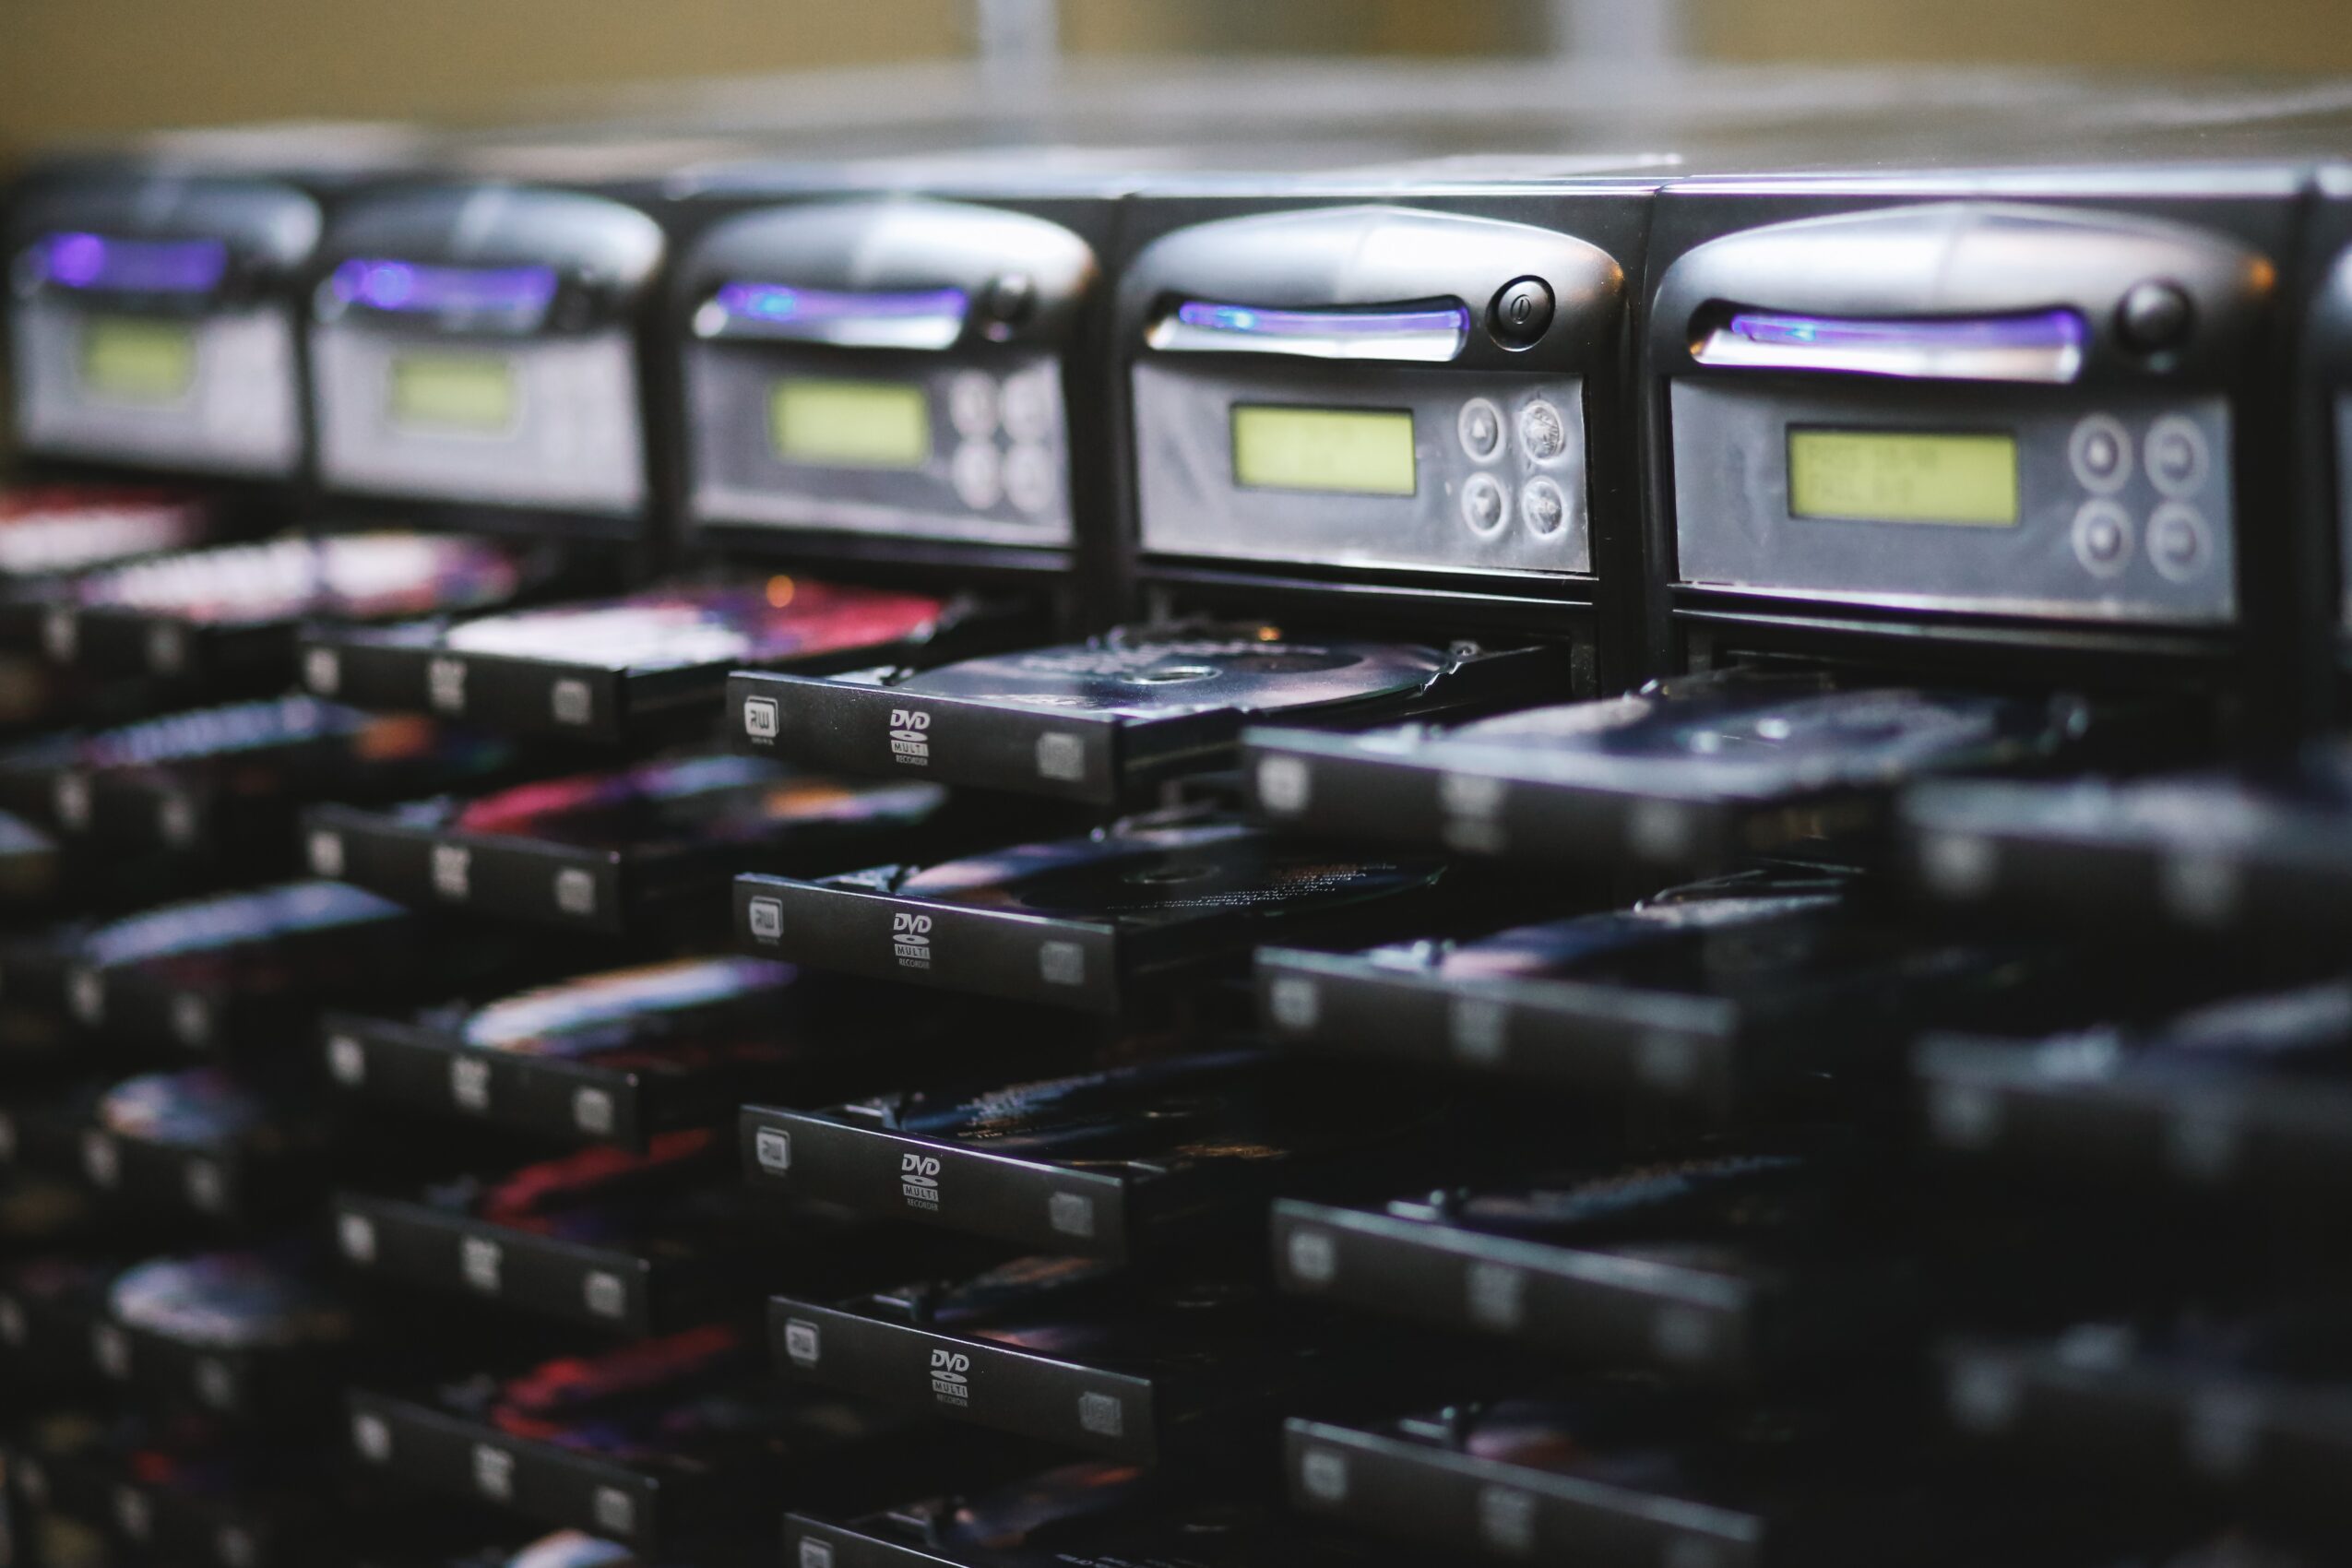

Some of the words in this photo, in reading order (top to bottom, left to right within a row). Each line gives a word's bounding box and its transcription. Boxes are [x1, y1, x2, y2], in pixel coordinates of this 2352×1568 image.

[890, 708, 931, 731] DVD
[893, 742, 927, 754] MULTI
[896, 754, 929, 766] RECORDER
[893, 912, 932, 935] DVD
[897, 944, 929, 959] MULTI
[901, 1153, 941, 1176] DVD
[905, 1184, 937, 1201] MULTI
[907, 1198, 939, 1212] RECORDER
[931, 1348, 970, 1372] DVD
[933, 1381, 967, 1396] MULTI
